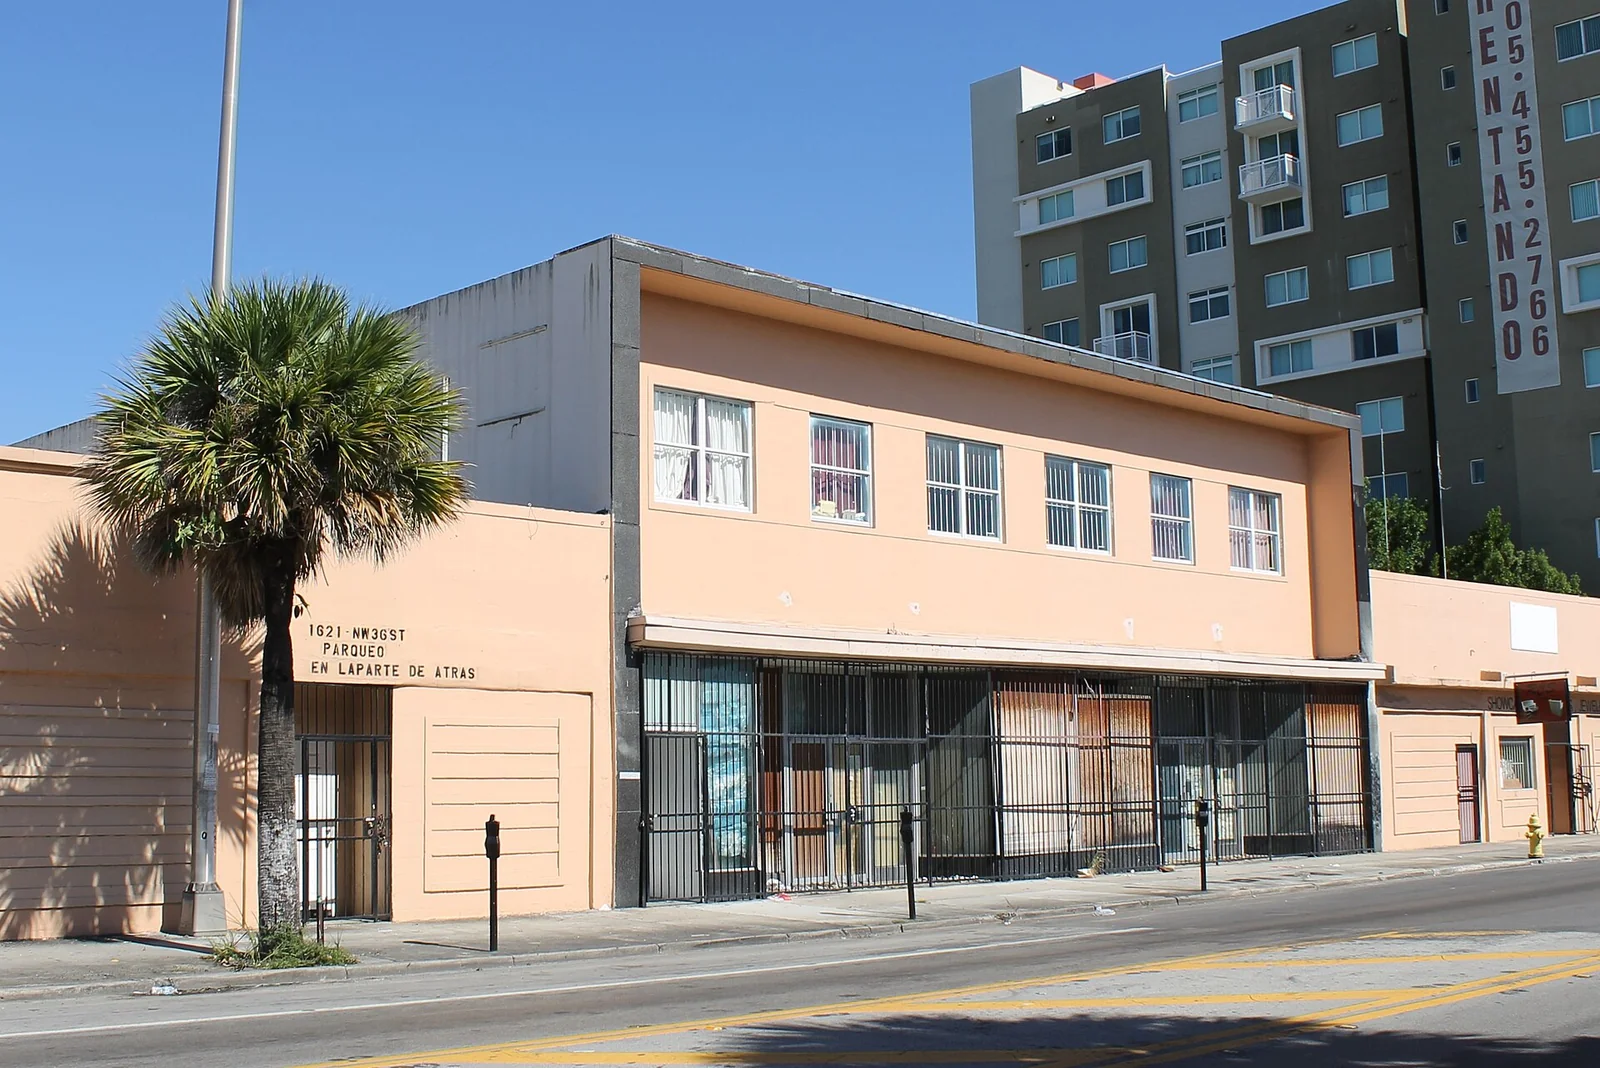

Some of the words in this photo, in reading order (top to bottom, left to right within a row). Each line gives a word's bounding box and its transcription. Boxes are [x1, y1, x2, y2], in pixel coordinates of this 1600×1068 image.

[323, 643, 385, 658] PARQUEO
[311, 661, 328, 674] EN
[339, 663, 399, 677] LAPARTE
[409, 665, 425, 678] DE
[435, 666, 476, 679] ATRAS
[1487, 696, 1515, 710] SHOWC
